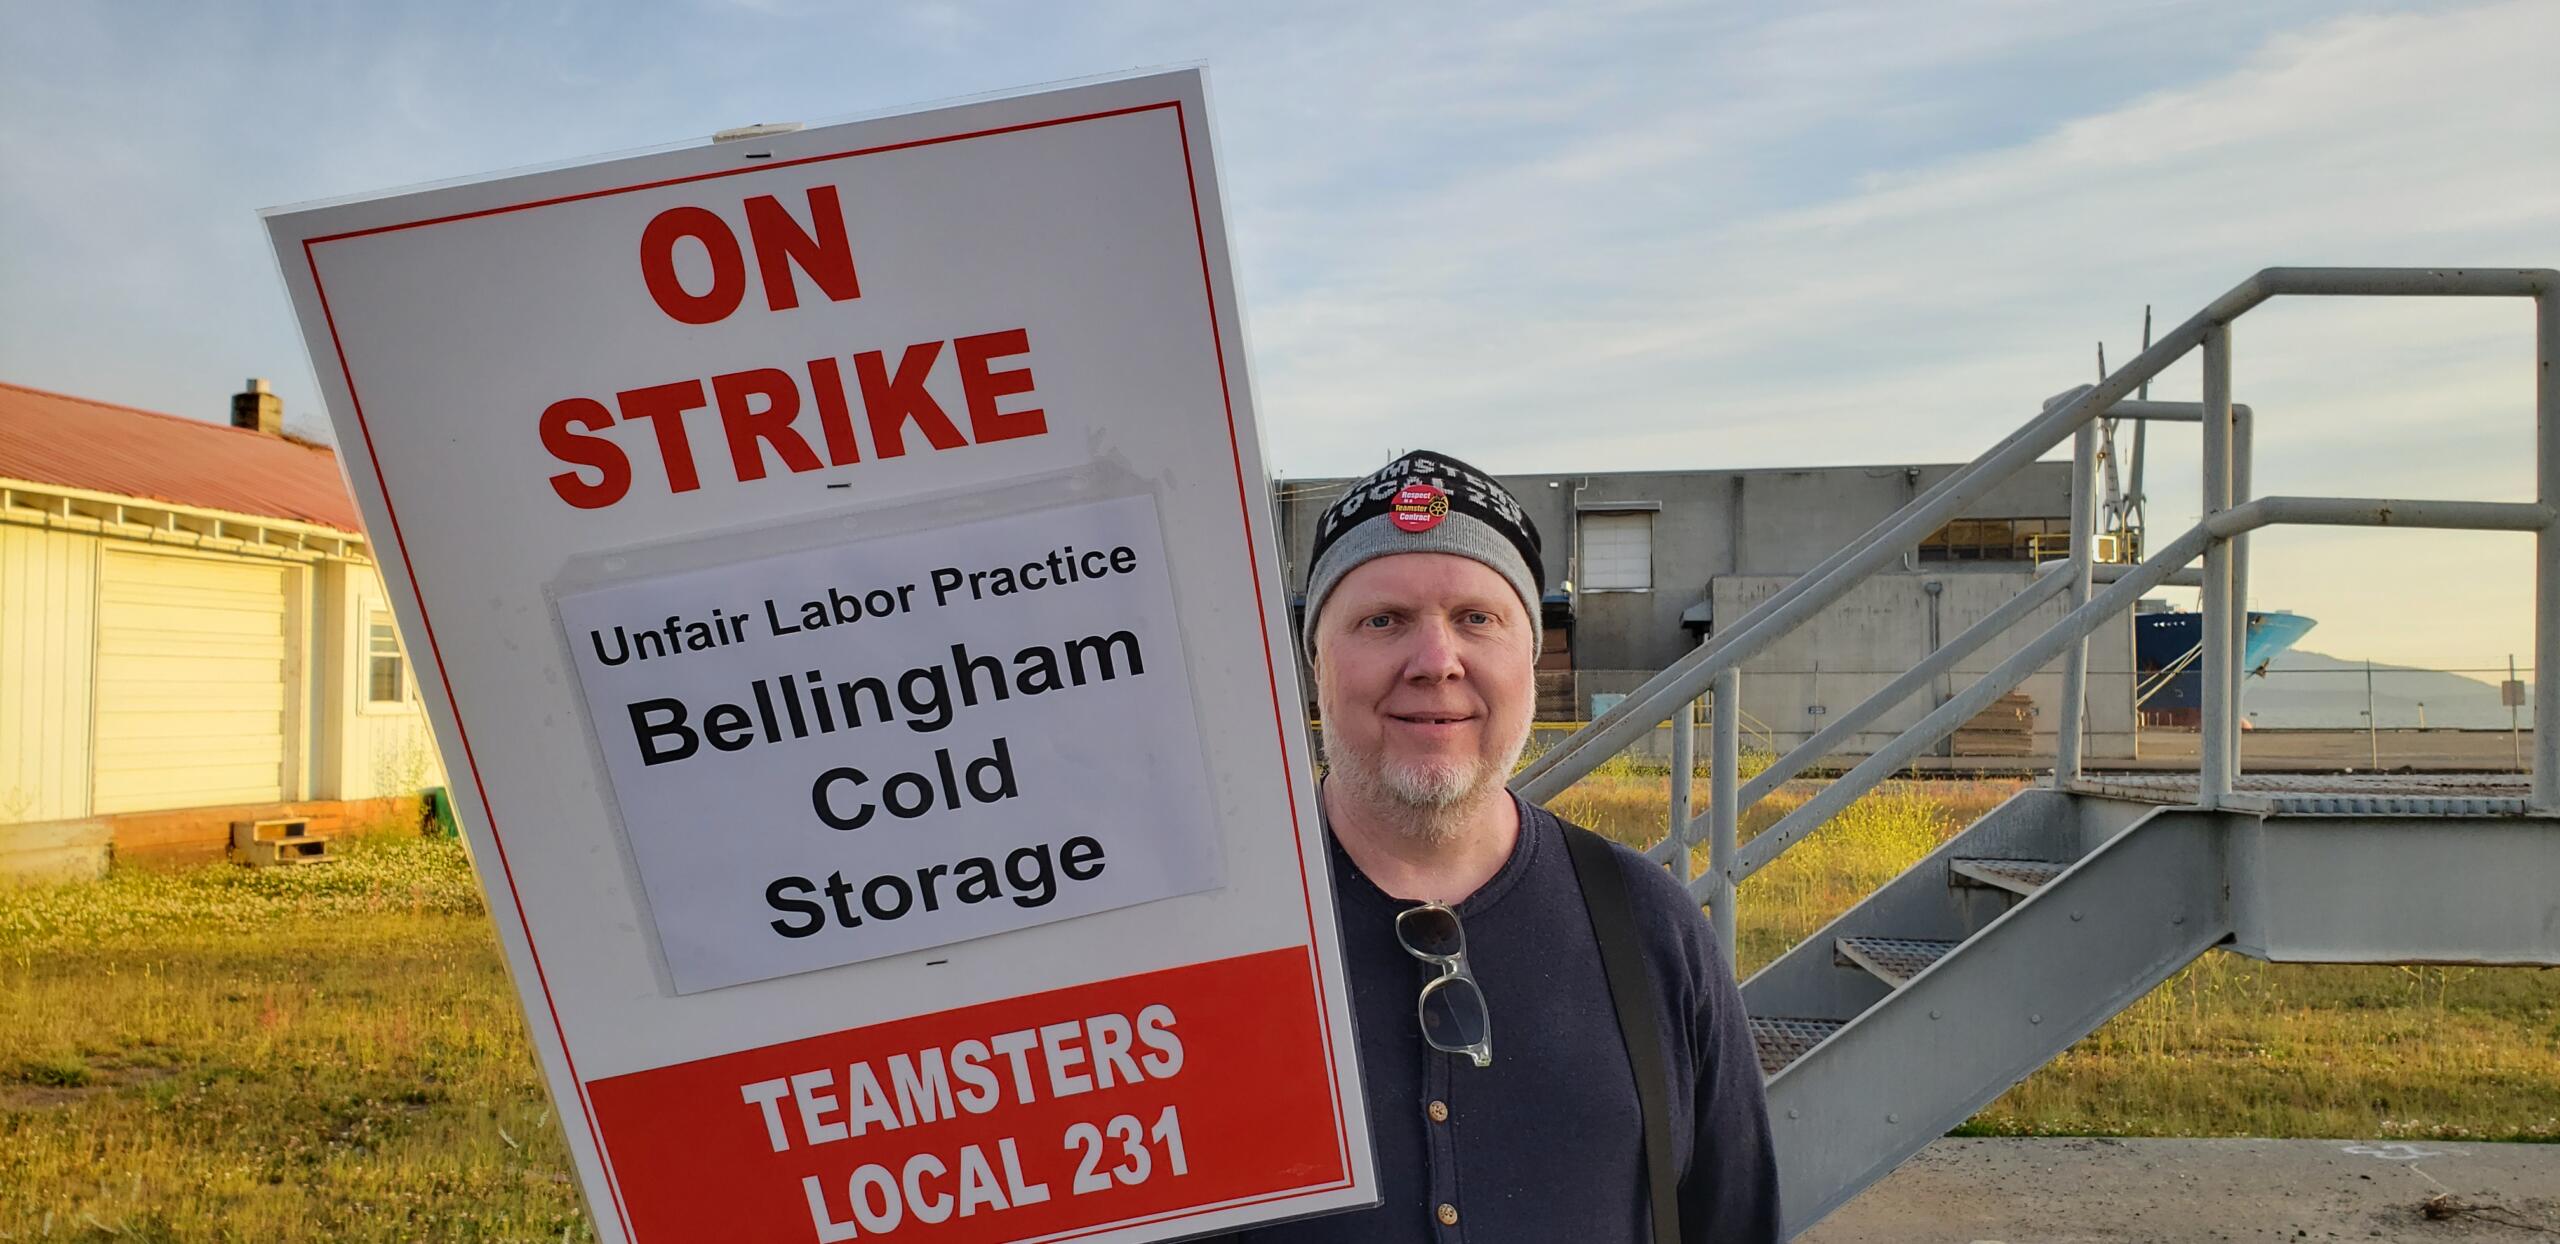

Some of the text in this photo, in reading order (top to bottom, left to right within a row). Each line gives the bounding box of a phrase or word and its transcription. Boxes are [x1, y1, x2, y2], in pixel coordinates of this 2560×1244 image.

[640, 185, 861, 325] ON
[539, 328, 1048, 510] STRIKE
[1395, 504, 1428, 512] Teamster
[1399, 513, 1430, 521] Contract
[1401, 491, 1431, 500] Respect
[590, 545, 1137, 667] Unfair Labor Practice
[626, 630, 1145, 767] Bellingham
[811, 736, 1019, 831] Cold
[765, 835, 1106, 939] Storage
[740, 1004, 1184, 1153] TEAMSTERS
[802, 1105, 1188, 1244] LOCAL 231
